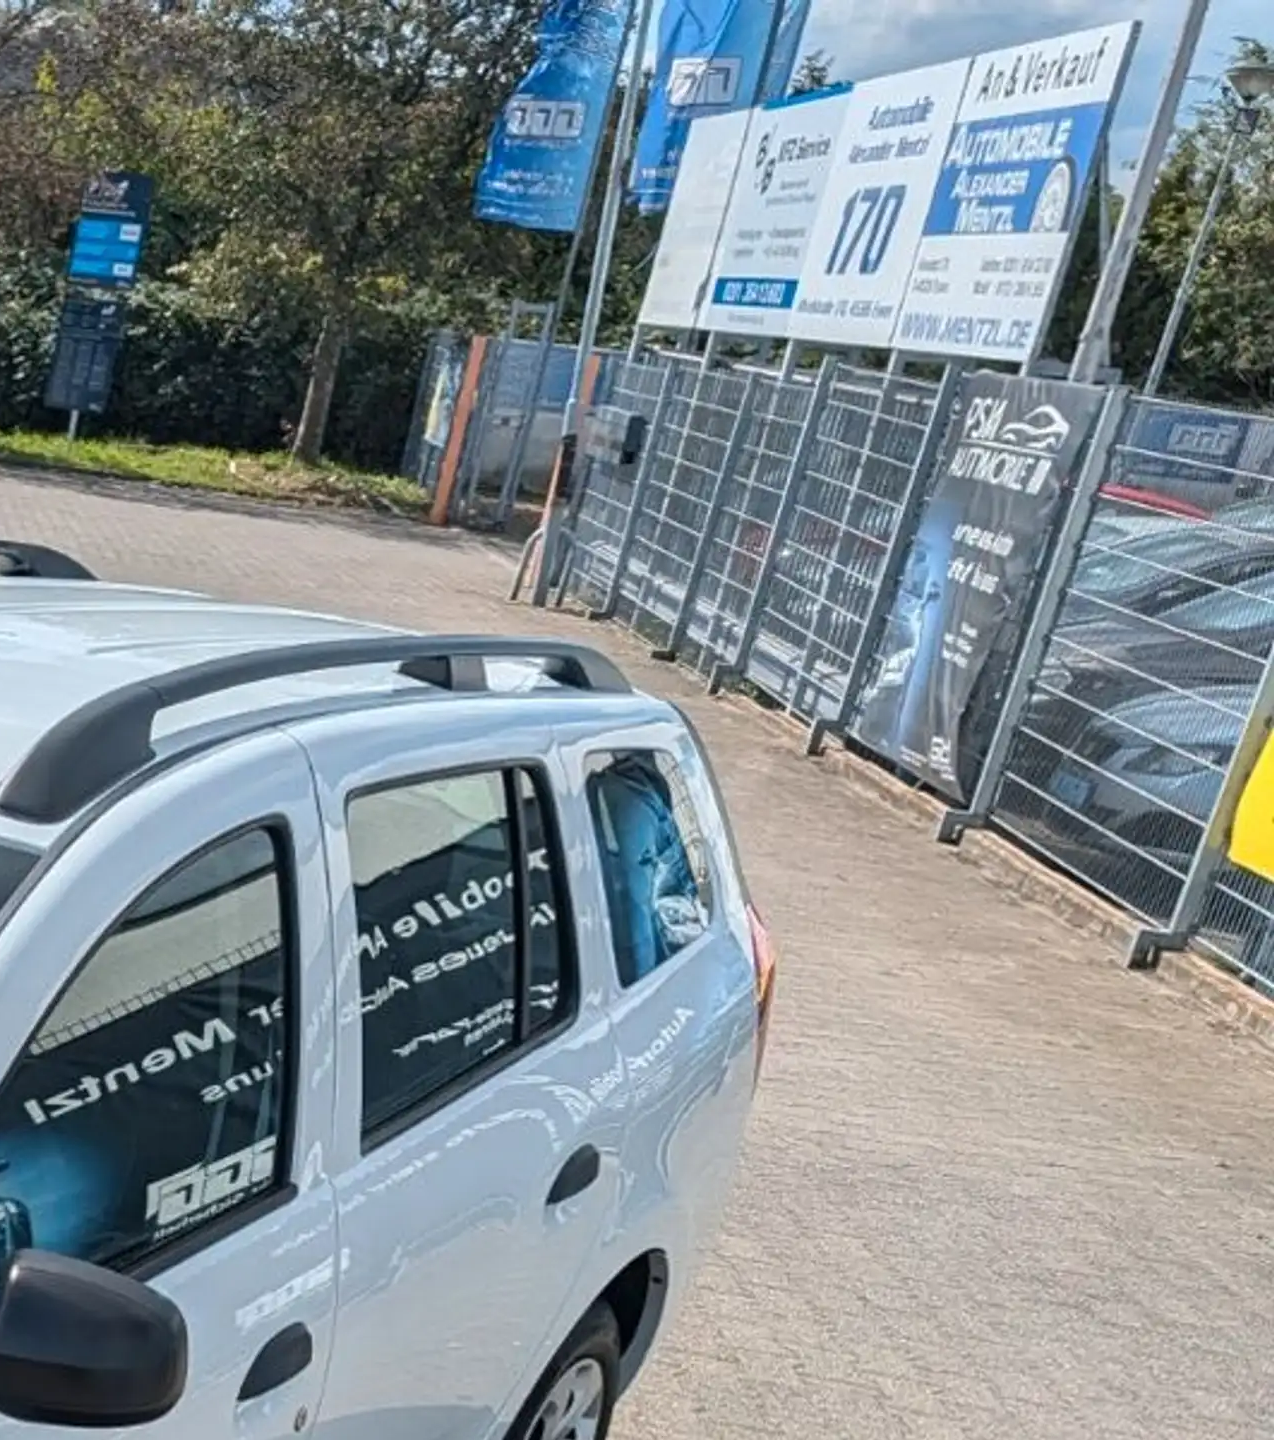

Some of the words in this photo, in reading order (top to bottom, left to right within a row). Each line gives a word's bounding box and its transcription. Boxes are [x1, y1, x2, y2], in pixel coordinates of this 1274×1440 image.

[977, 61, 1004, 102] An
[1004, 54, 1024, 98] &
[1022, 36, 1110, 94] Verkauf
[825, 185, 907, 275] 170
[962, 398, 1008, 441] PSM
